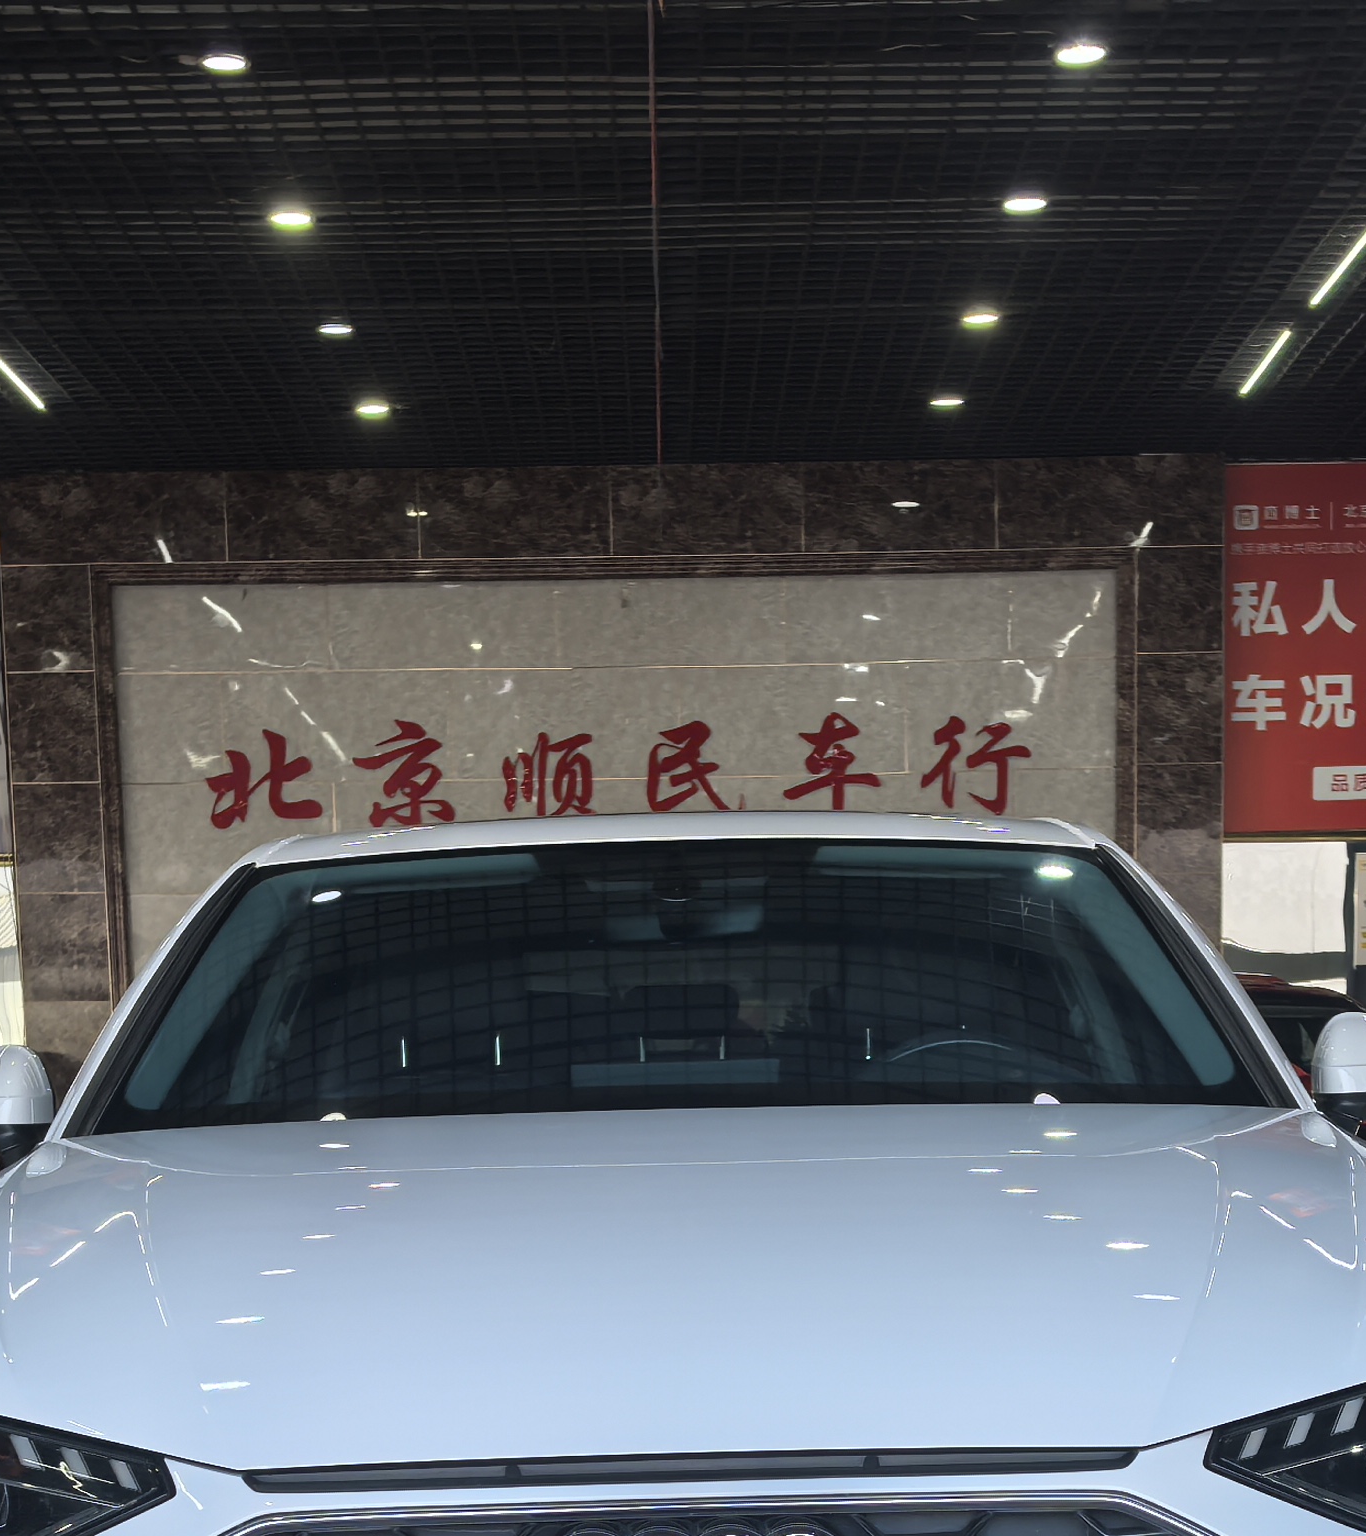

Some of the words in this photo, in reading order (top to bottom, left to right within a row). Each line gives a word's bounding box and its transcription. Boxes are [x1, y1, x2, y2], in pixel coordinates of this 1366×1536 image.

[205, 711, 1032, 829] 北京顺民车行
